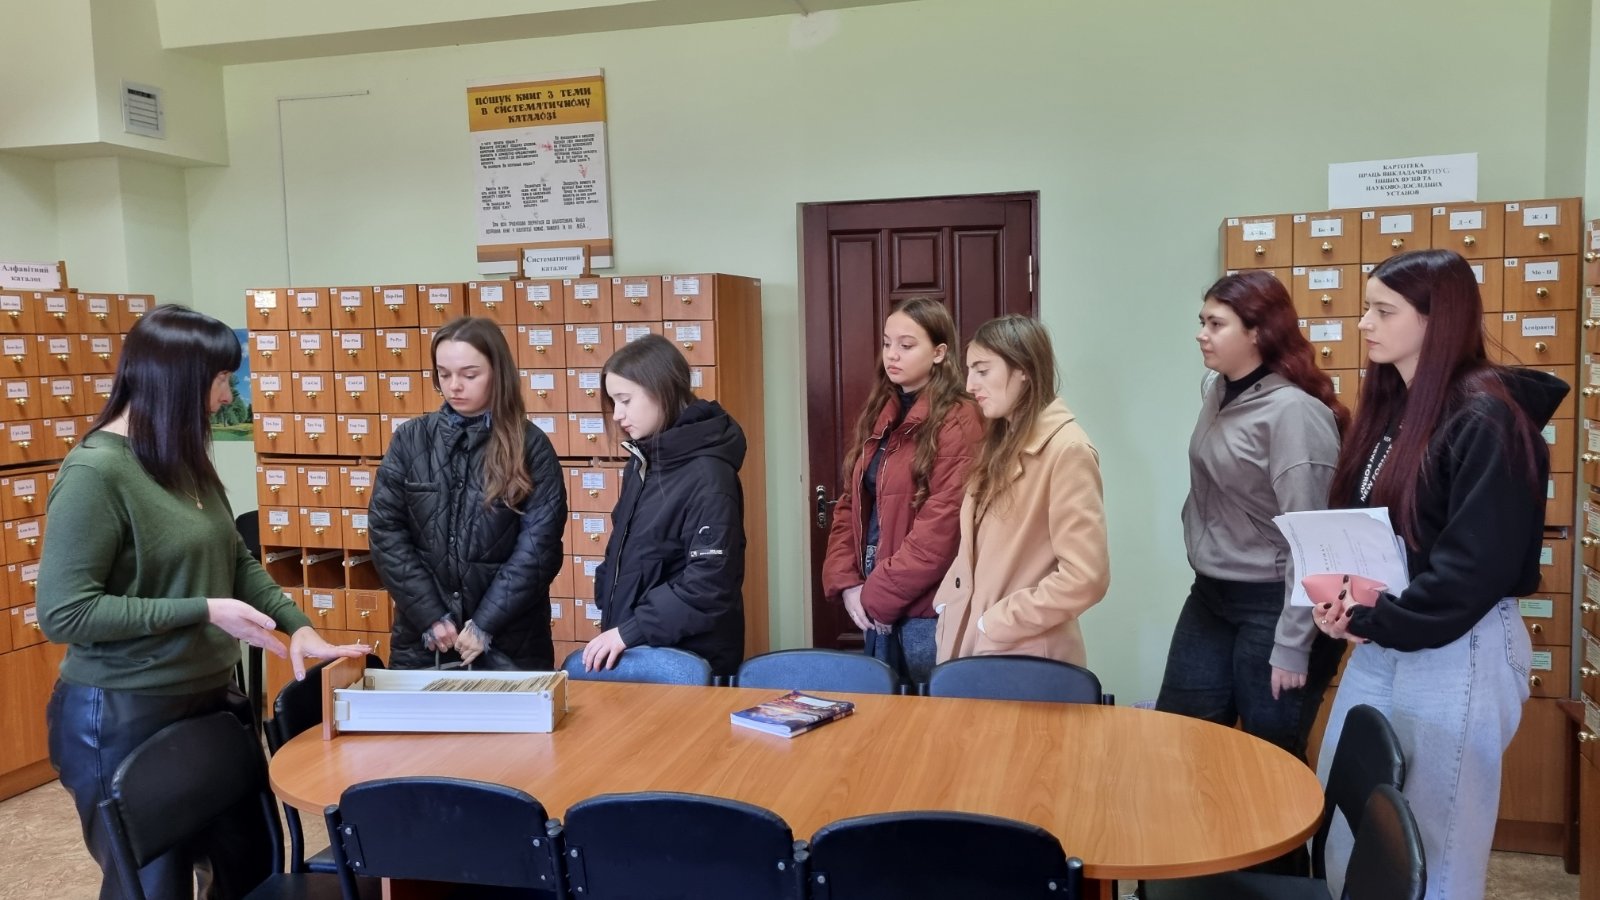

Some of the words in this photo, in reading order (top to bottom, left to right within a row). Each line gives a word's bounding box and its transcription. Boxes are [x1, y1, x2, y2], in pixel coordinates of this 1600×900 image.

[474, 95, 511, 106] ПОШУК
[515, 92, 542, 102] КНИГ
[559, 87, 591, 97] ТЕМИ
[481, 107, 488, 116] В
[494, 98, 591, 115] СИСТЕМАТИЧНОМУ
[508, 110, 557, 124] КАТАЛОЗІ
[1383, 162, 1424, 170] КАРТОТЕКА
[526, 254, 581, 264] Систематичний
[2, 264, 49, 274] Алфавітний
[11, 275, 41, 283] каталог
[1360, 480, 1373, 502] NEW
